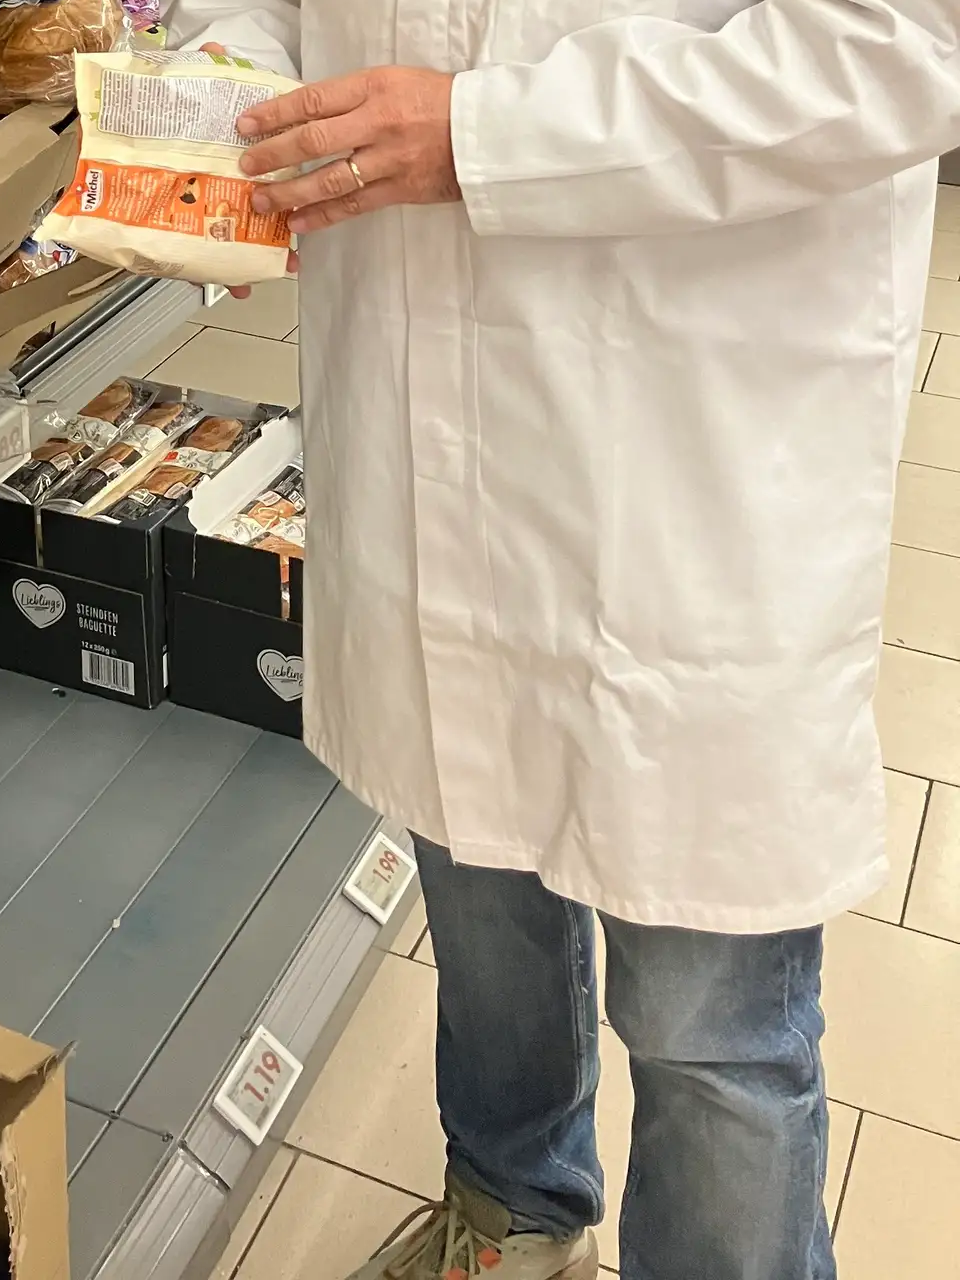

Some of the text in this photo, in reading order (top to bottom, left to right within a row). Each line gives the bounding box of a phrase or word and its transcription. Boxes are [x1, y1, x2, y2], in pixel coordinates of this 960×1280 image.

[88, 170, 102, 206] Michel
[21, 592, 61, 611] Lieblings
[76, 603, 119, 624] STEINOFEN
[78, 616, 117, 637] BAGUETTE
[373, 849, 400, 884] 1.99
[243, 1050, 282, 1102] 1.19
